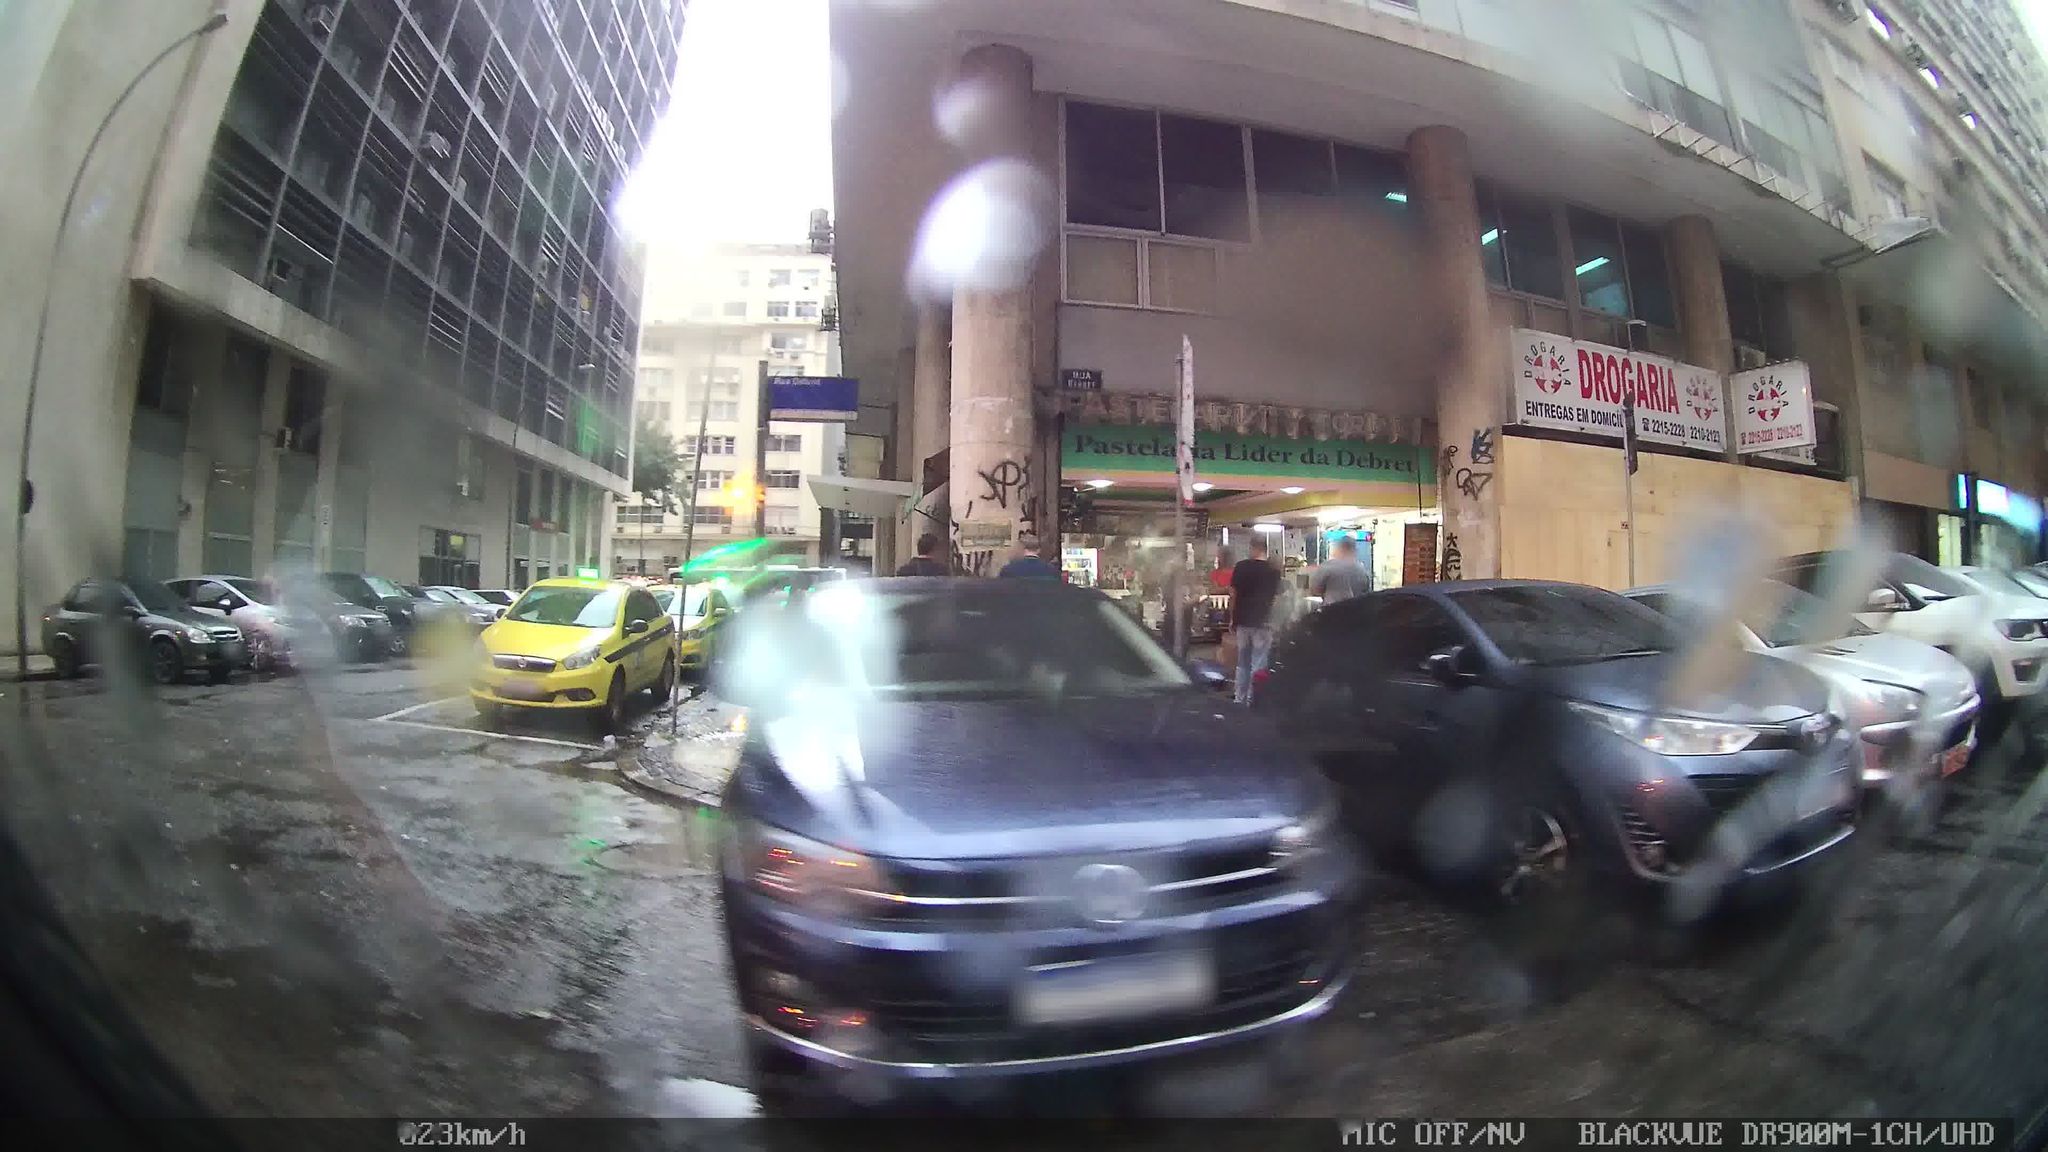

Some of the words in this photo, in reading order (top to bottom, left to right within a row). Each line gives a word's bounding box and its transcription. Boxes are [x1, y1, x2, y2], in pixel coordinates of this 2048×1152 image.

[1523, 341, 1571, 385] DROGARIA
[1577, 348, 1680, 414] DROGARIA
[1525, 400, 1574, 421] ENTREGAS
[1576, 407, 1589, 423] EM
[1591, 405, 1625, 428] DOMICÍL
[1747, 375, 1789, 414] DROGARIA
[1075, 434, 1216, 460] Pastelaia
[1300, 447, 1330, 466] da
